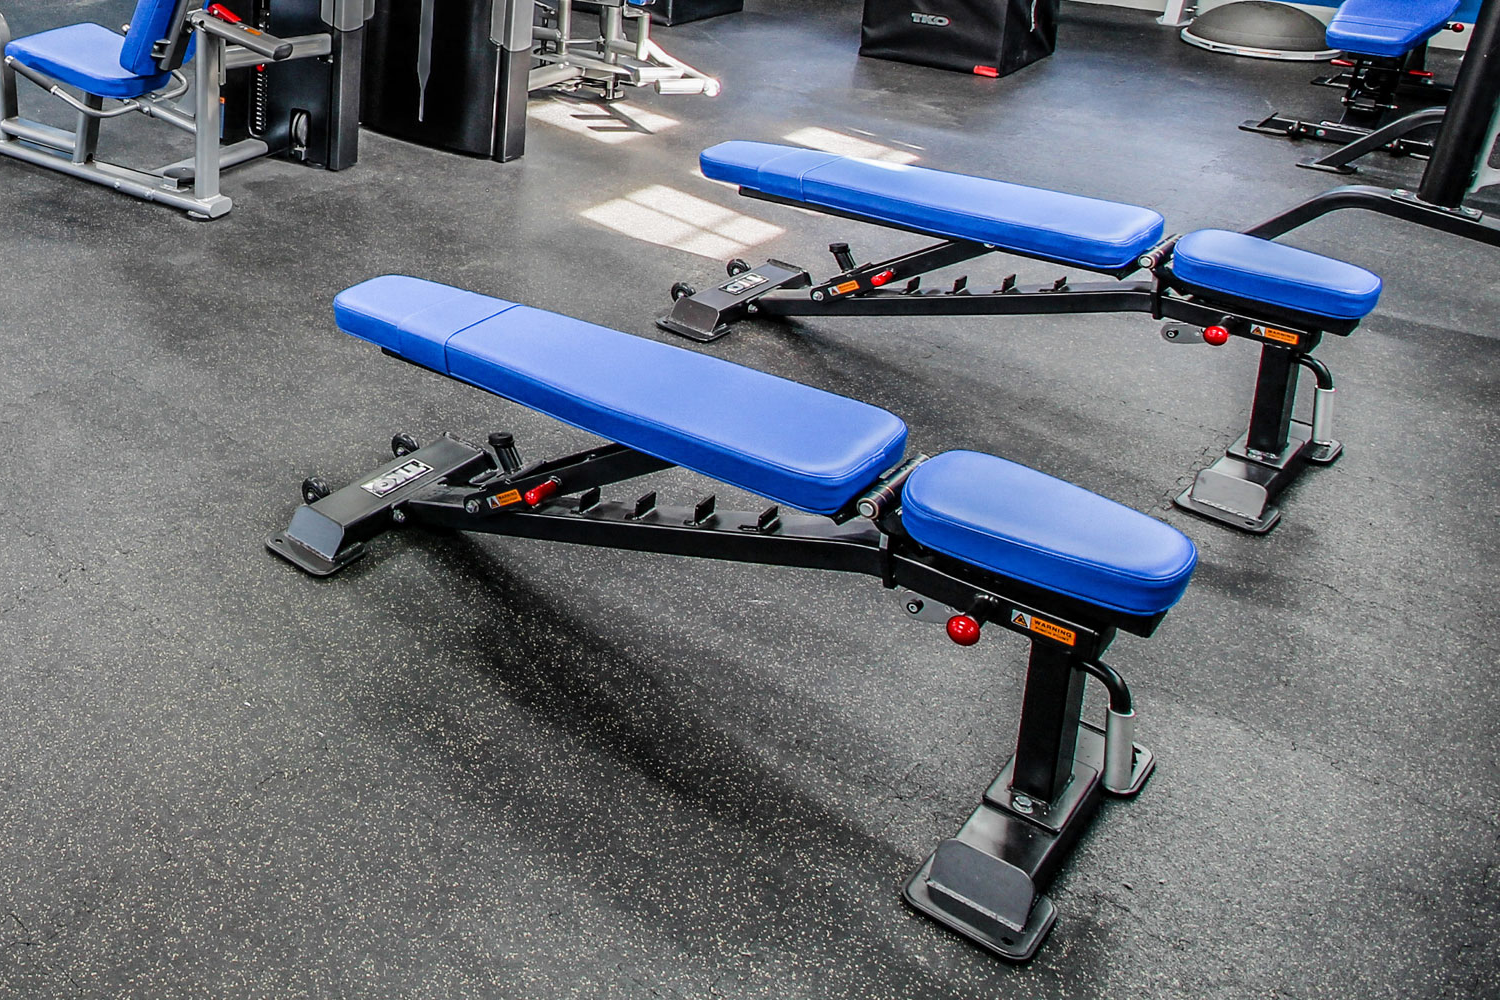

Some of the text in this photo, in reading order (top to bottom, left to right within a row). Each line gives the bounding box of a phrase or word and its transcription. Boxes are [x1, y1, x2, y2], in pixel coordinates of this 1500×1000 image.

[911, 12, 951, 27] TKO
[372, 461, 428, 496] TKO
[1034, 619, 1072, 638] WARNING
